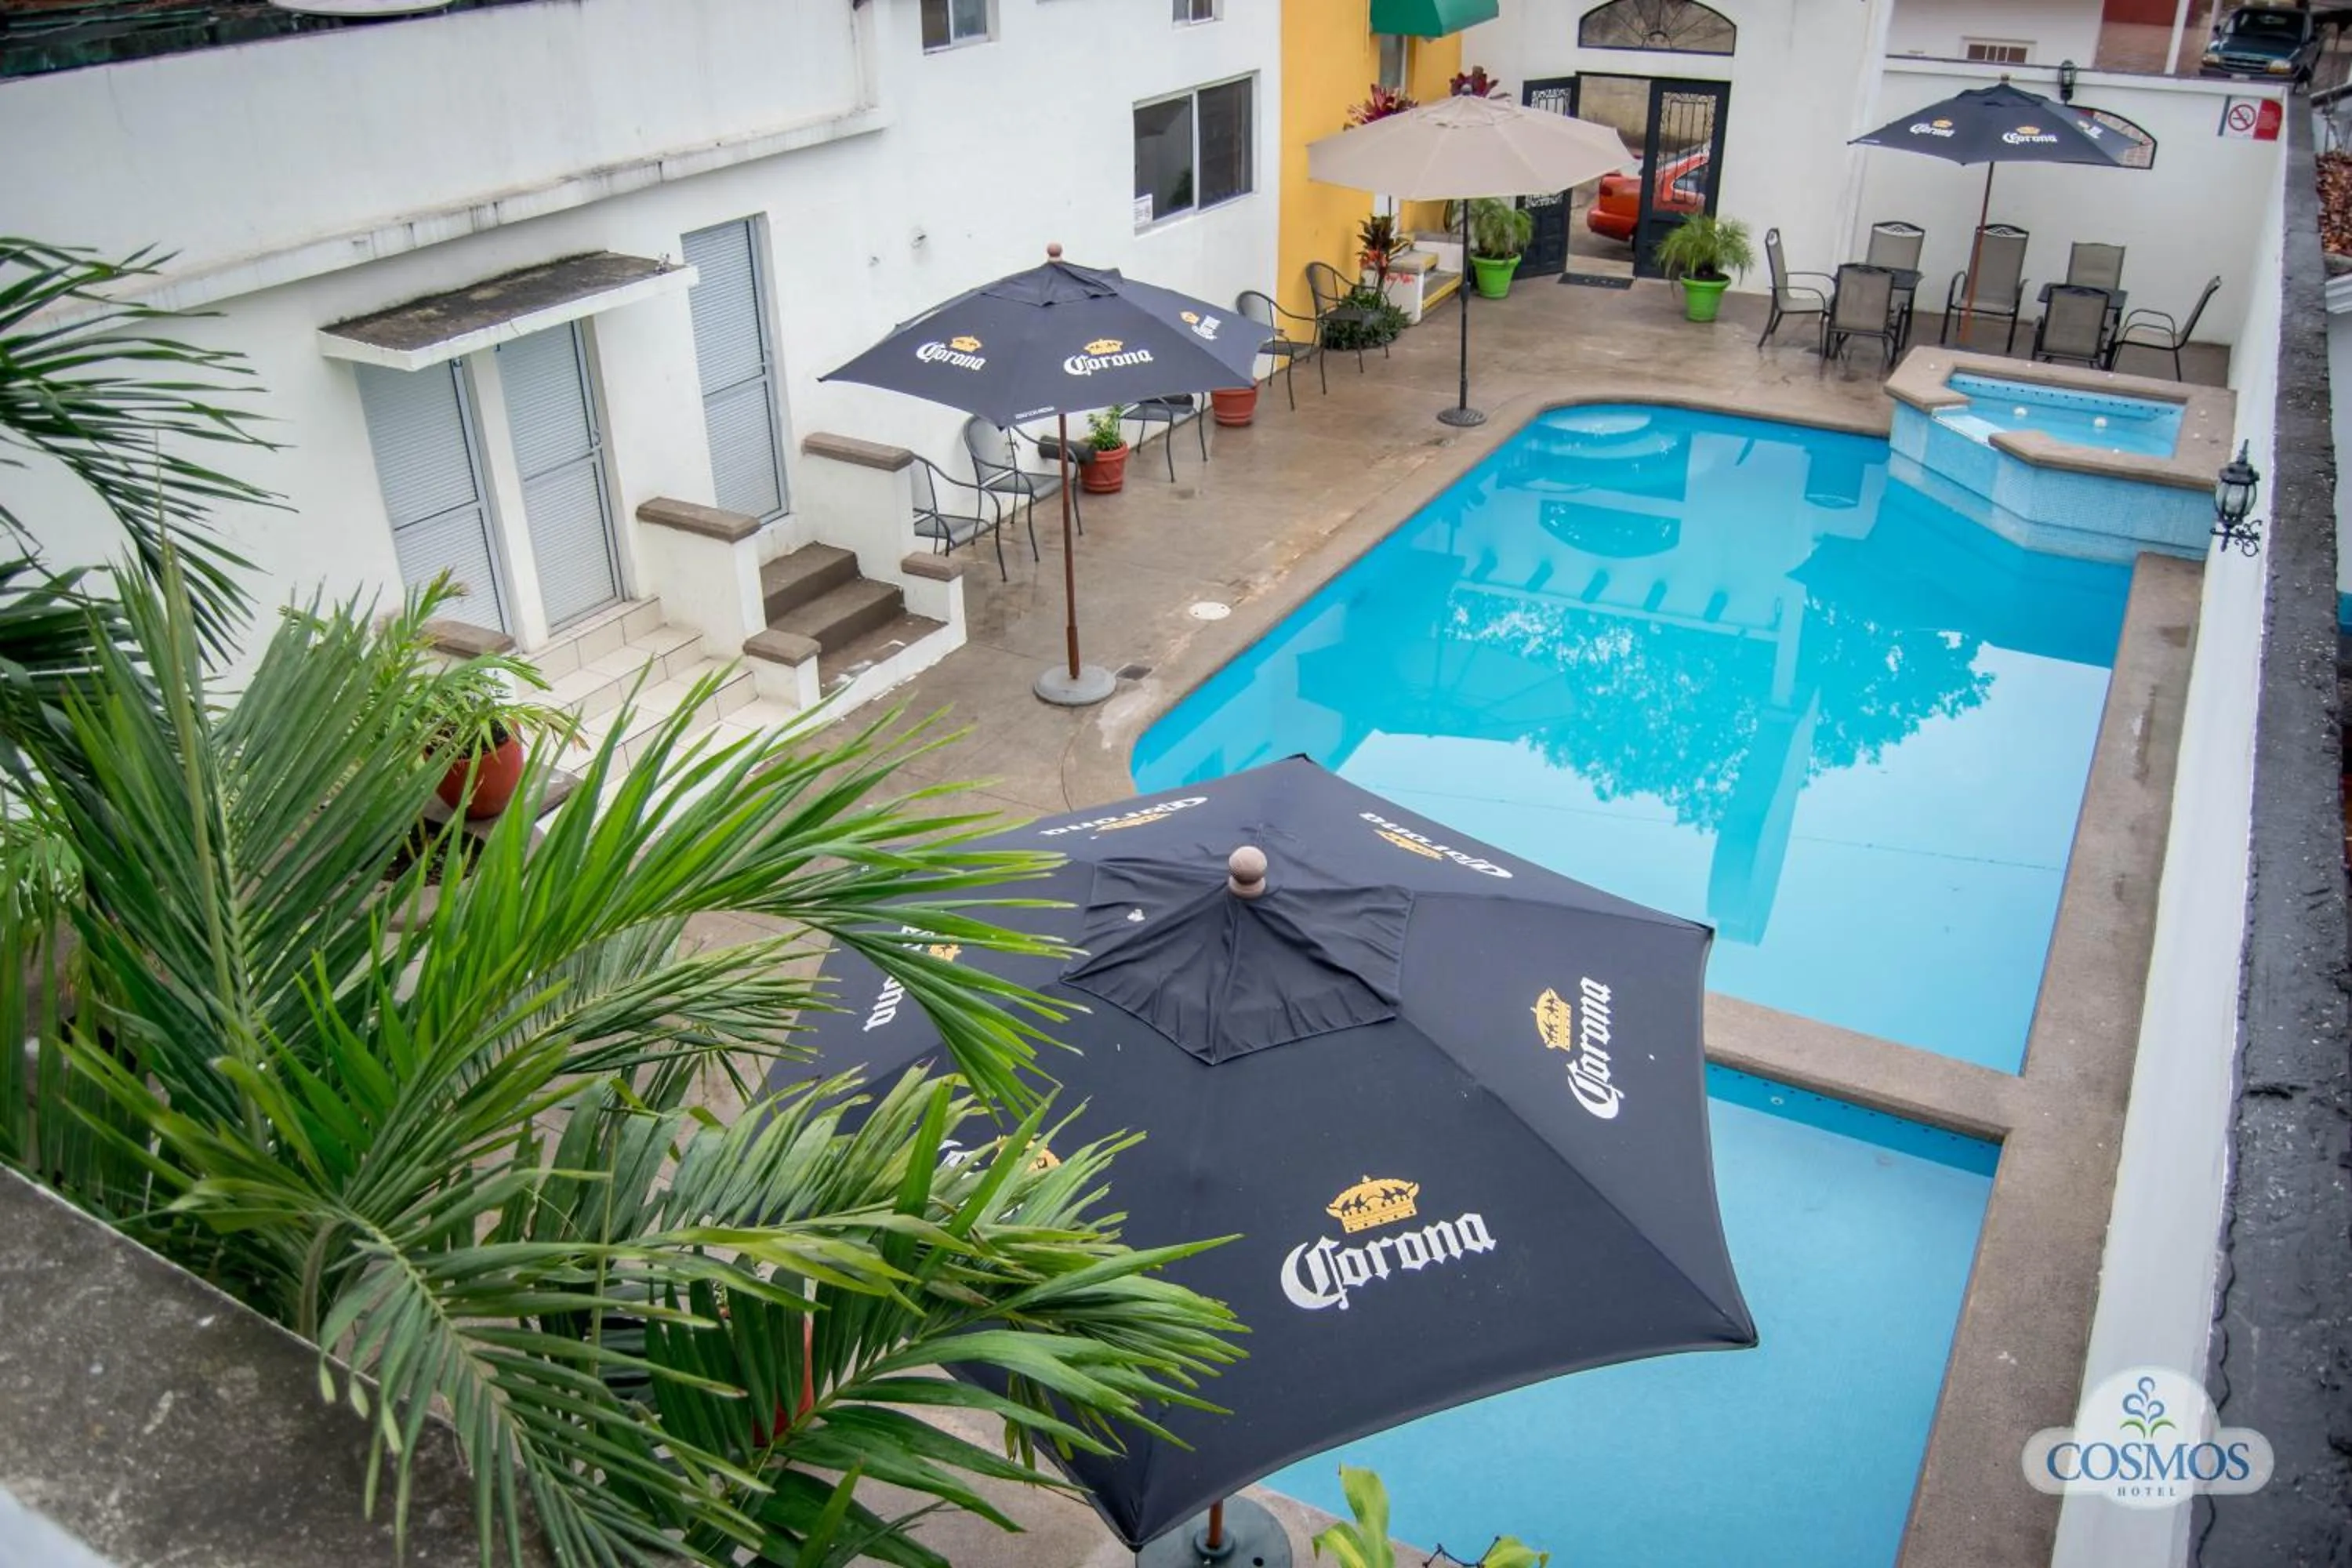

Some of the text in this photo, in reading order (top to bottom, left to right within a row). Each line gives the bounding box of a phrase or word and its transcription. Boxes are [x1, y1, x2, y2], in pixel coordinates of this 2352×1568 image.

[2002, 132, 2059, 145] Corona
[916, 341, 986, 371] Corona
[1063, 349, 1154, 376] Corona
[1566, 977, 1625, 1120] Corona
[1280, 1212, 1497, 1310] Corona
